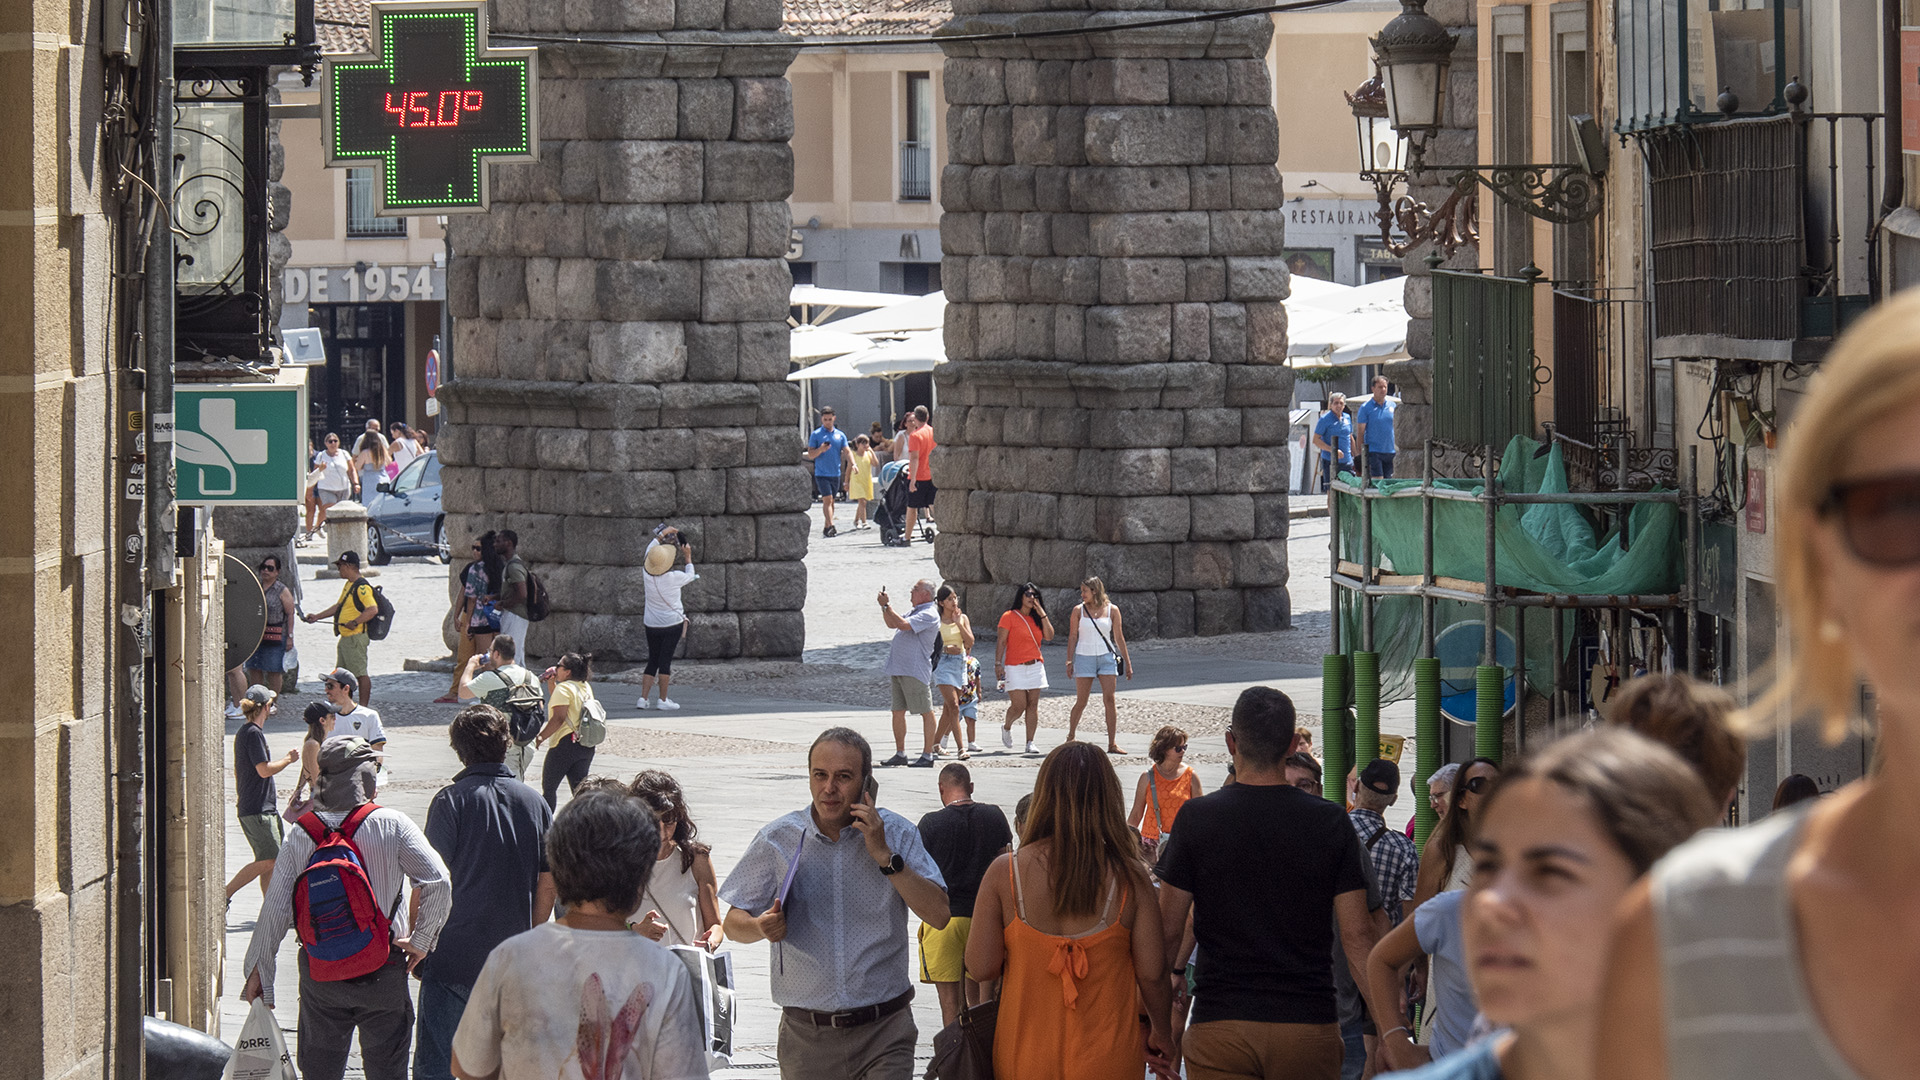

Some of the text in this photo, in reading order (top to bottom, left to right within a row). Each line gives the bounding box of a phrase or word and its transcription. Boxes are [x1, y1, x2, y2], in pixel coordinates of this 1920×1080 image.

[285, 266, 433, 303] DE 1954
[239, 1037, 271, 1049] TORRE
